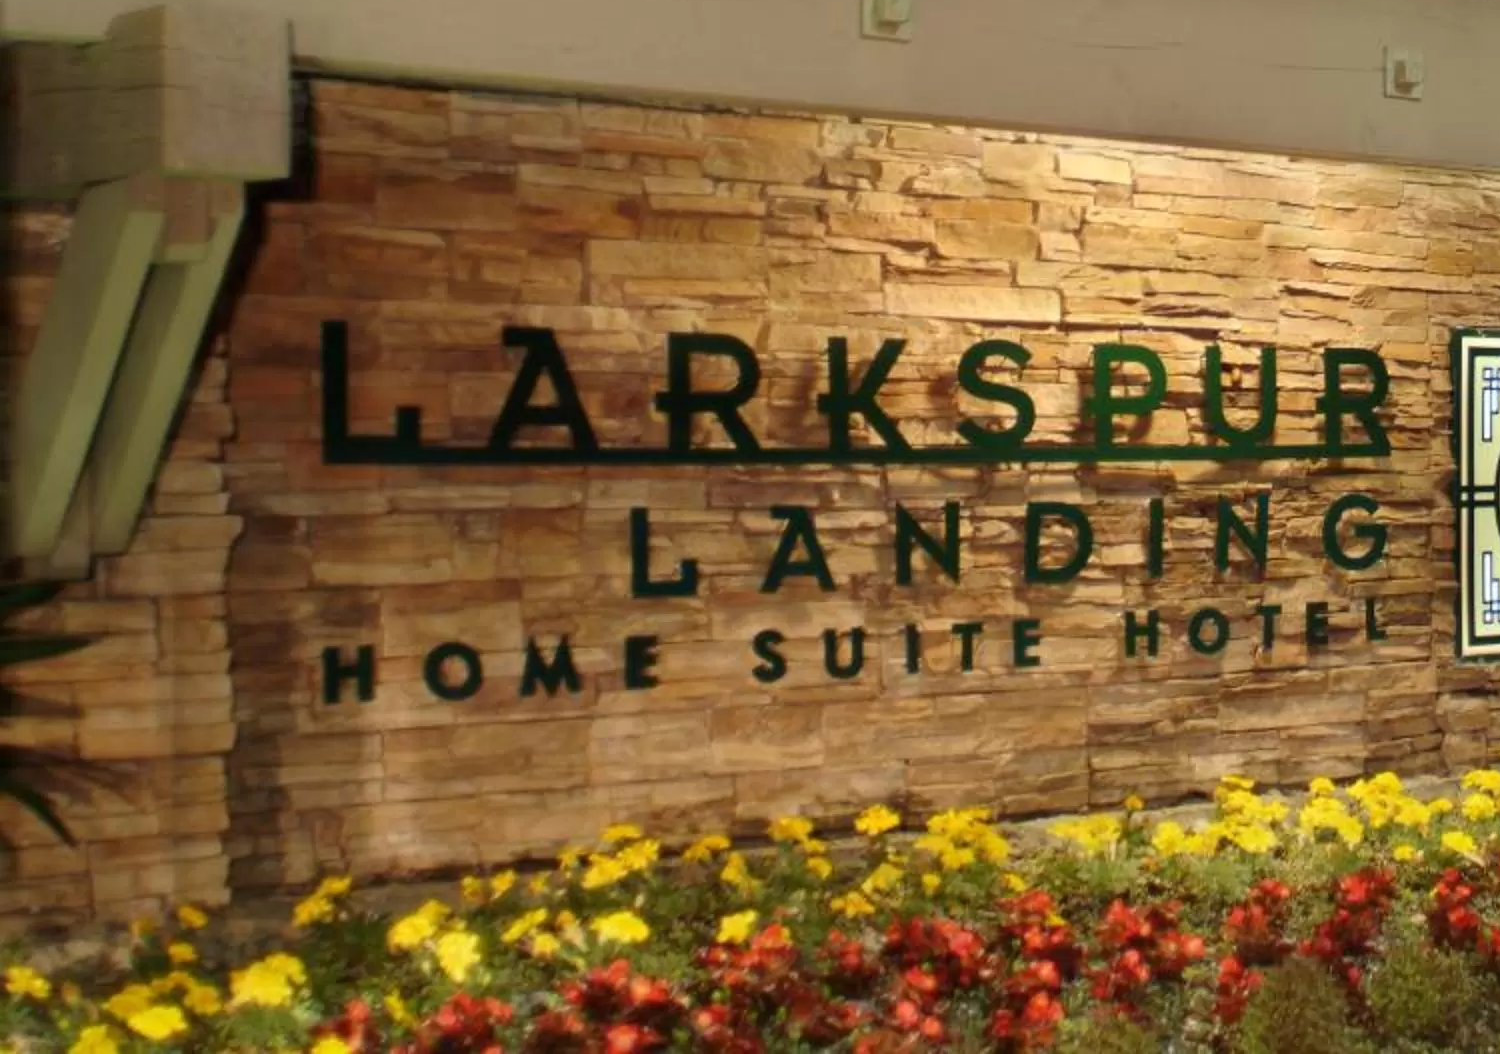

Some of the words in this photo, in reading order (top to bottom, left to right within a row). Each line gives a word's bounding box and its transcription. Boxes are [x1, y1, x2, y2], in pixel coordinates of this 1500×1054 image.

[322, 320, 1391, 464] LARKSPUR
[630, 492, 1388, 598] LANDING
[322, 635, 661, 704] HOME
[751, 618, 1042, 684] SUITE
[1123, 597, 1387, 658] HOTEL
